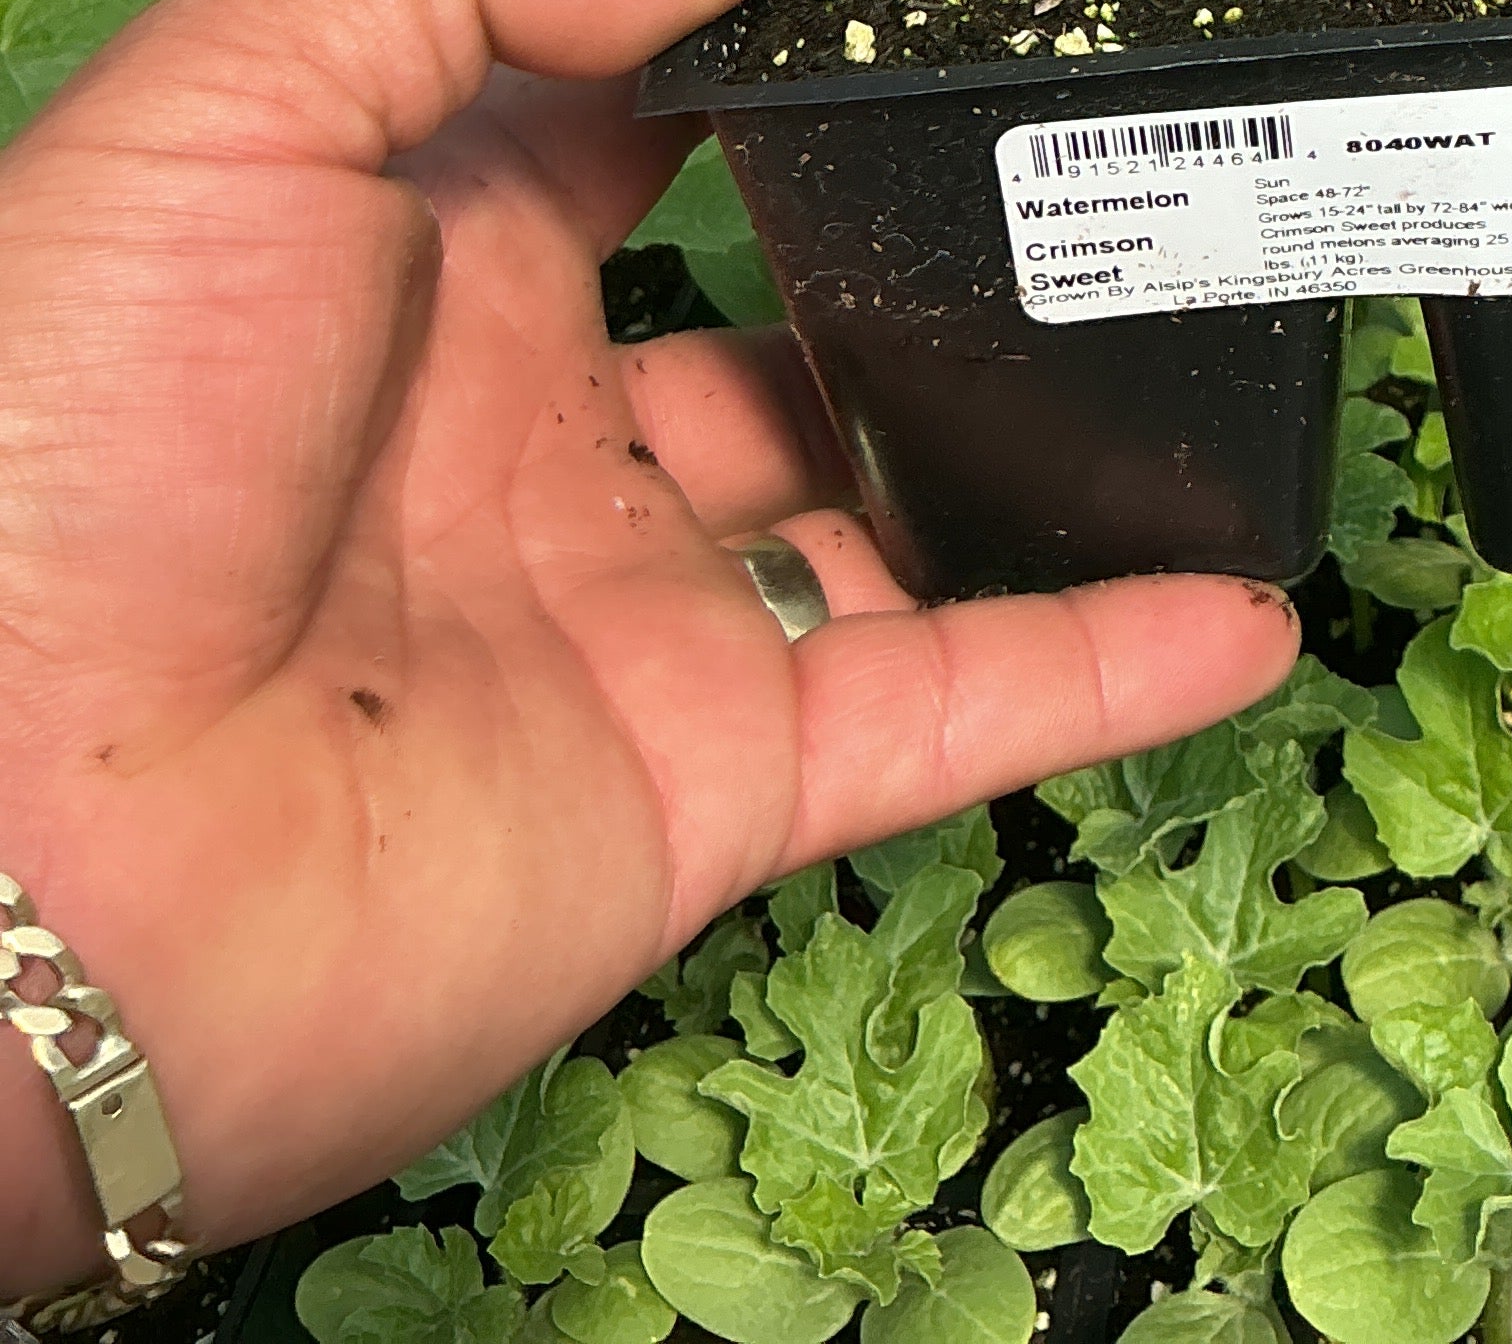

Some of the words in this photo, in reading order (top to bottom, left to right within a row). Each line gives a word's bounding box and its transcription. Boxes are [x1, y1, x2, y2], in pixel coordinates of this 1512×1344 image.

[1346, 131, 1496, 154] 8040WAT
[1067, 159, 1158, 179] 91521
[1174, 151, 1263, 171] 24464
[1254, 177, 1290, 190] Sun
[1016, 190, 1190, 221] Watermelon
[1256, 192, 1310, 207] Space
[1258, 211, 1312, 224] Grows
[1377, 202, 1401, 215] tall
[1406, 202, 1426, 216] by
[1260, 223, 1335, 240] Crimson
[1341, 220, 1397, 232] Sweet
[1401, 218, 1487, 232] produces
[1025, 235, 1155, 262] Crimson
[1262, 238, 1315, 255] round
[1320, 237, 1387, 250] melons
[1391, 236, 1480, 249] averaging
[1485, 233, 1509, 246] 25
[1029, 290, 1100, 306] Grown
[1108, 285, 1135, 300] By
[1143, 278, 1211, 293] Alsip's
[1218, 269, 1323, 287] Kingsbury
[1331, 266, 1392, 278] Acres
[1030, 264, 1124, 292] Sweet
[1173, 294, 1197, 306] La
[1268, 286, 1290, 299] IN
[1296, 280, 1357, 295] 46350
